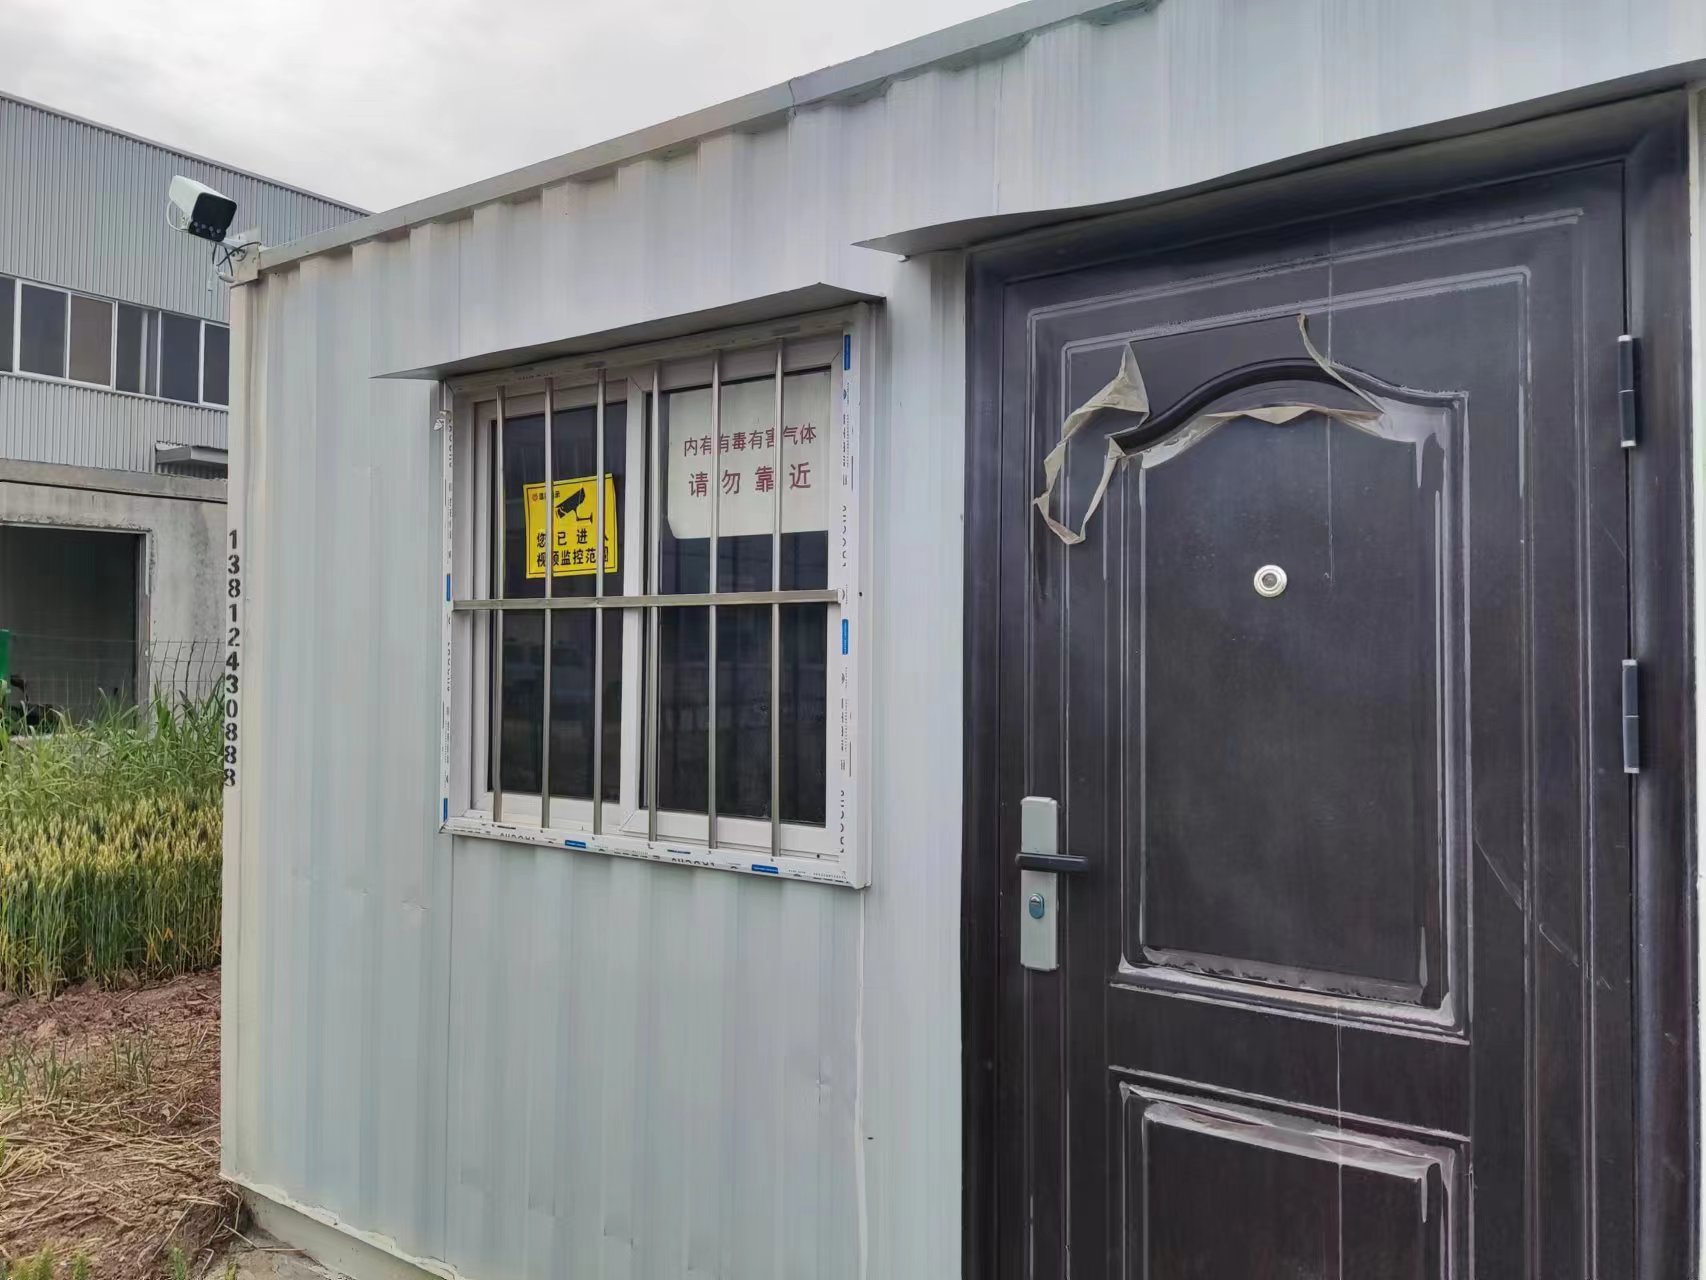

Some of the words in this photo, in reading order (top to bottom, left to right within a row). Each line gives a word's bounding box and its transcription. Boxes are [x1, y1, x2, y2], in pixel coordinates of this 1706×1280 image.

[684, 422, 817, 456] 内有有毒有害气体
[688, 462, 811, 497] 请勿靠近
[224, 529, 241, 787] 13812430888
